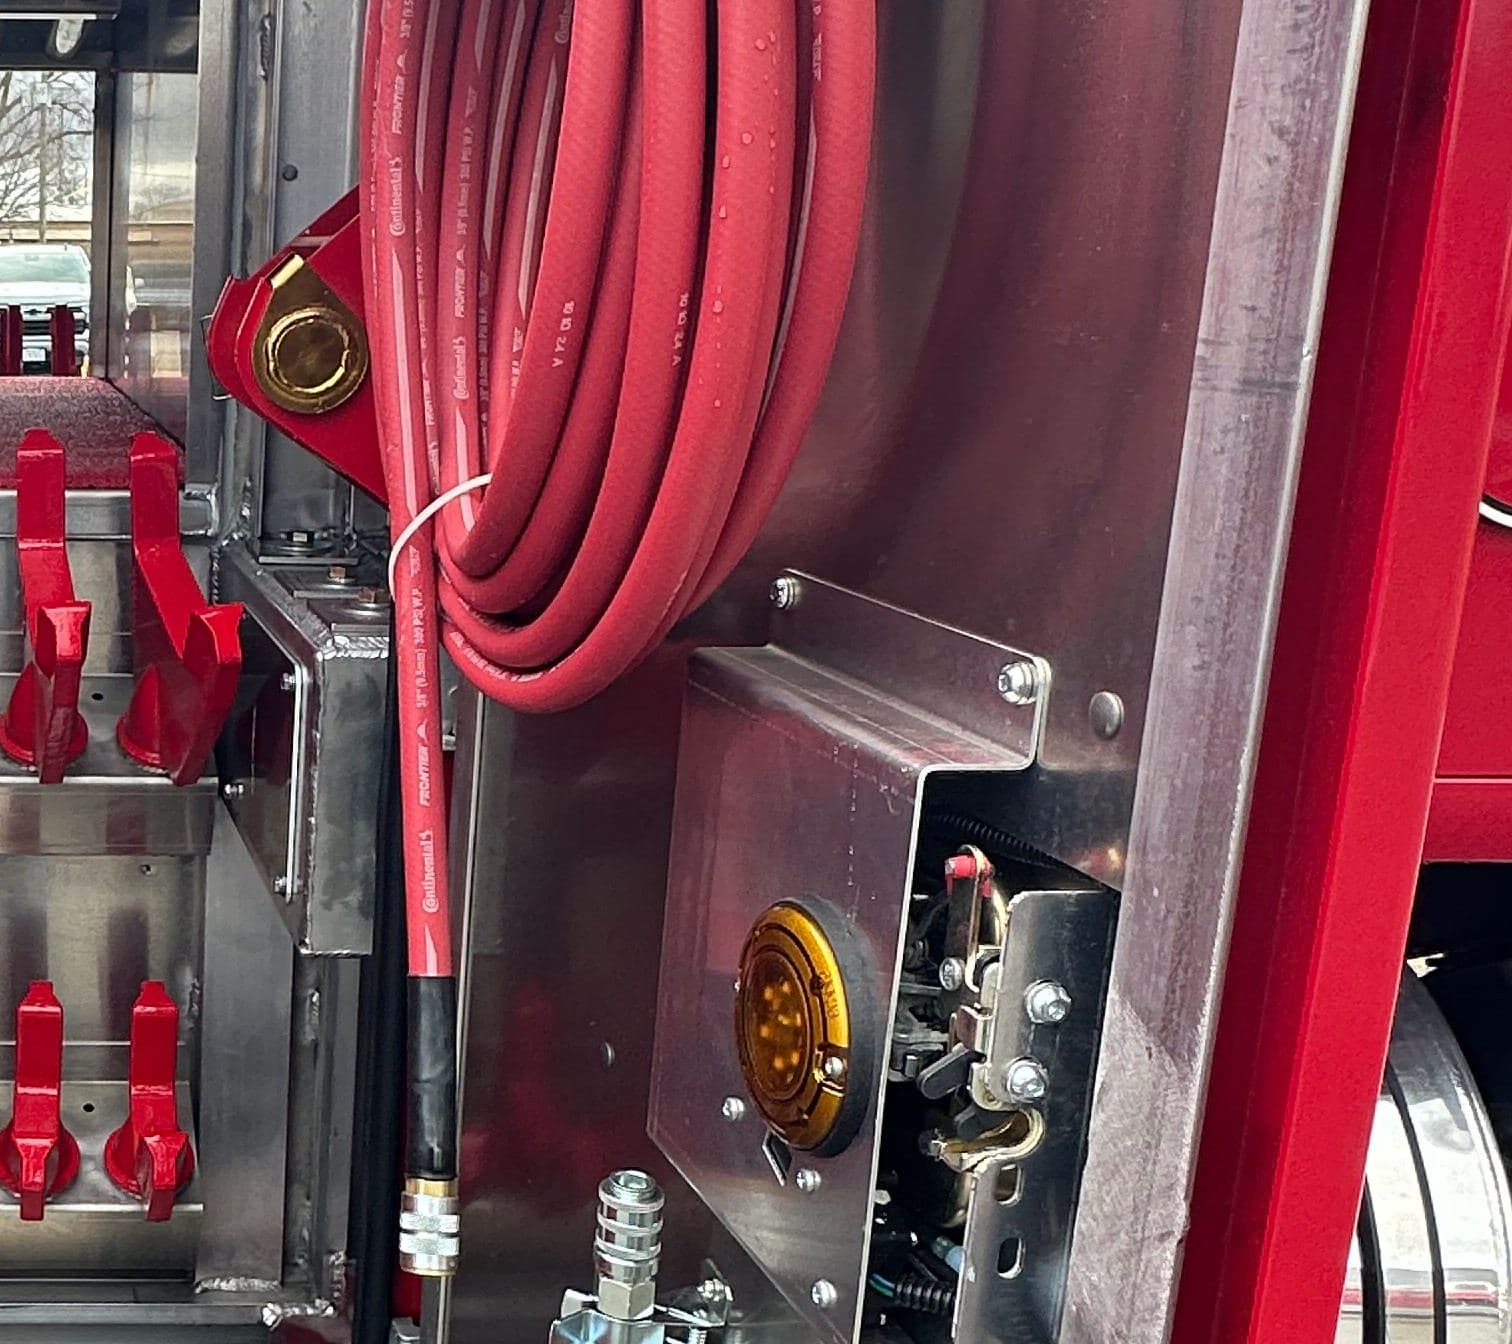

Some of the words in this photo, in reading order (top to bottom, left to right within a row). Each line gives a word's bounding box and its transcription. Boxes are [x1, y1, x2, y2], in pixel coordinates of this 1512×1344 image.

[392, 75, 405, 135] FRONTIER
[390, 167, 405, 236] Continental
[454, 267, 466, 318] FRONTIER
[453, 344, 469, 400] Continental
[418, 743, 431, 806] FRONTIER
[422, 835, 438, 913] Continental
